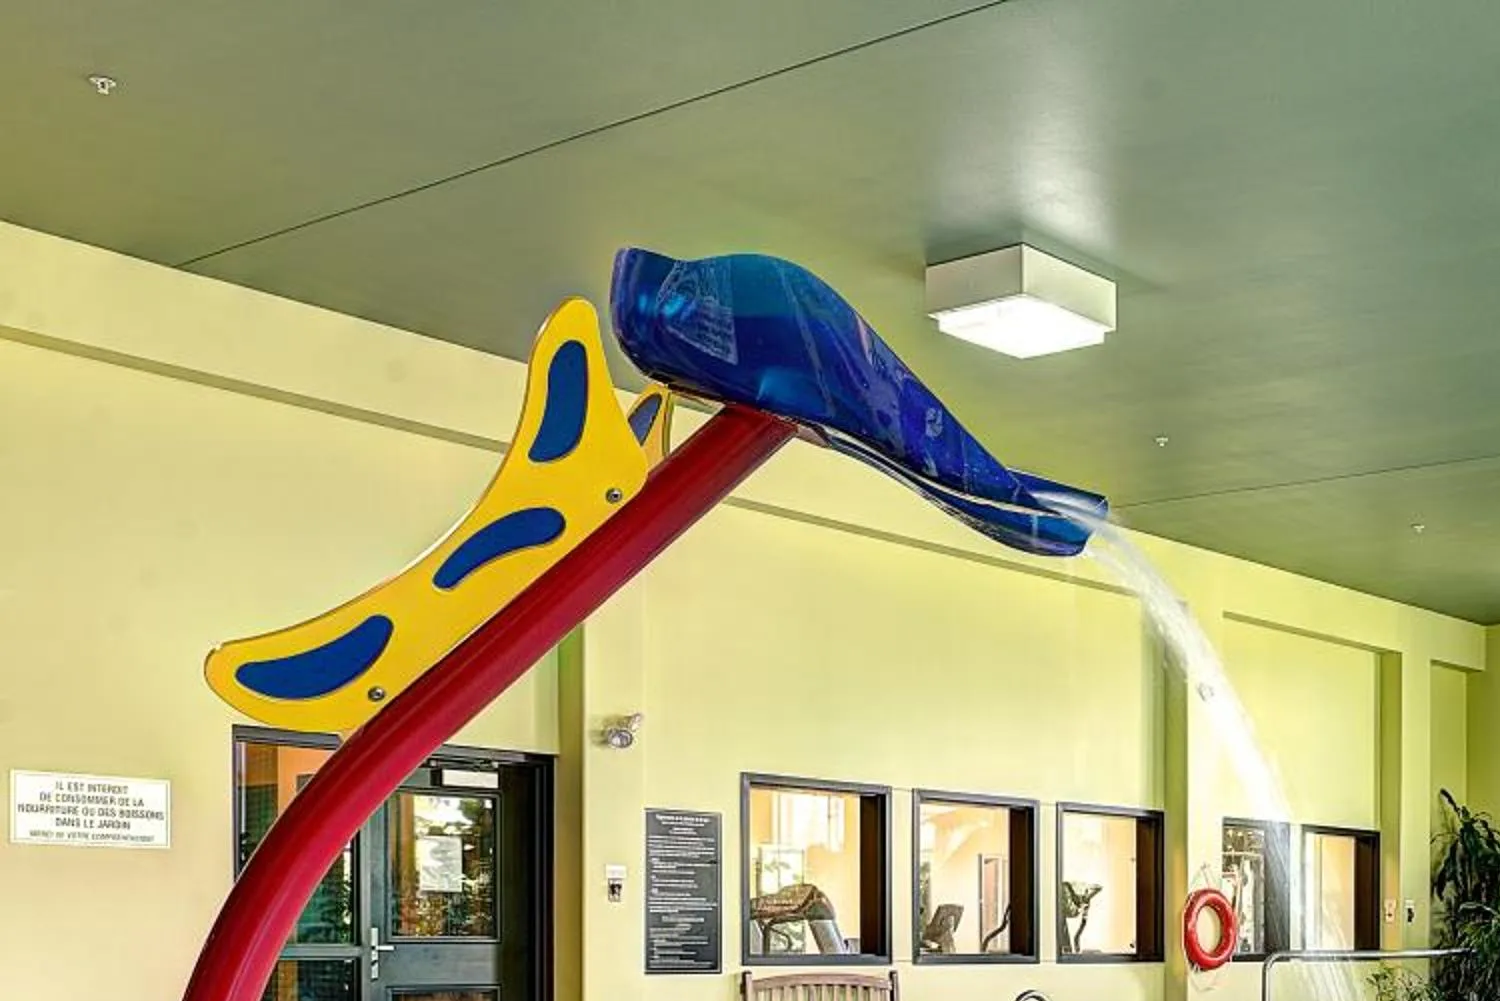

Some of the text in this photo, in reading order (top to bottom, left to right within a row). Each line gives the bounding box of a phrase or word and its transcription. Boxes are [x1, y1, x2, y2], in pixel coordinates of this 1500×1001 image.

[55, 781, 64, 791] IL
[68, 782, 85, 792] EST
[40, 791, 52, 802] DE
[118, 796, 130, 807] DE
[132, 797, 145, 807] LA
[98, 807, 117, 818] DES
[55, 817, 81, 828] DANS
[83, 818, 95, 829] LE
